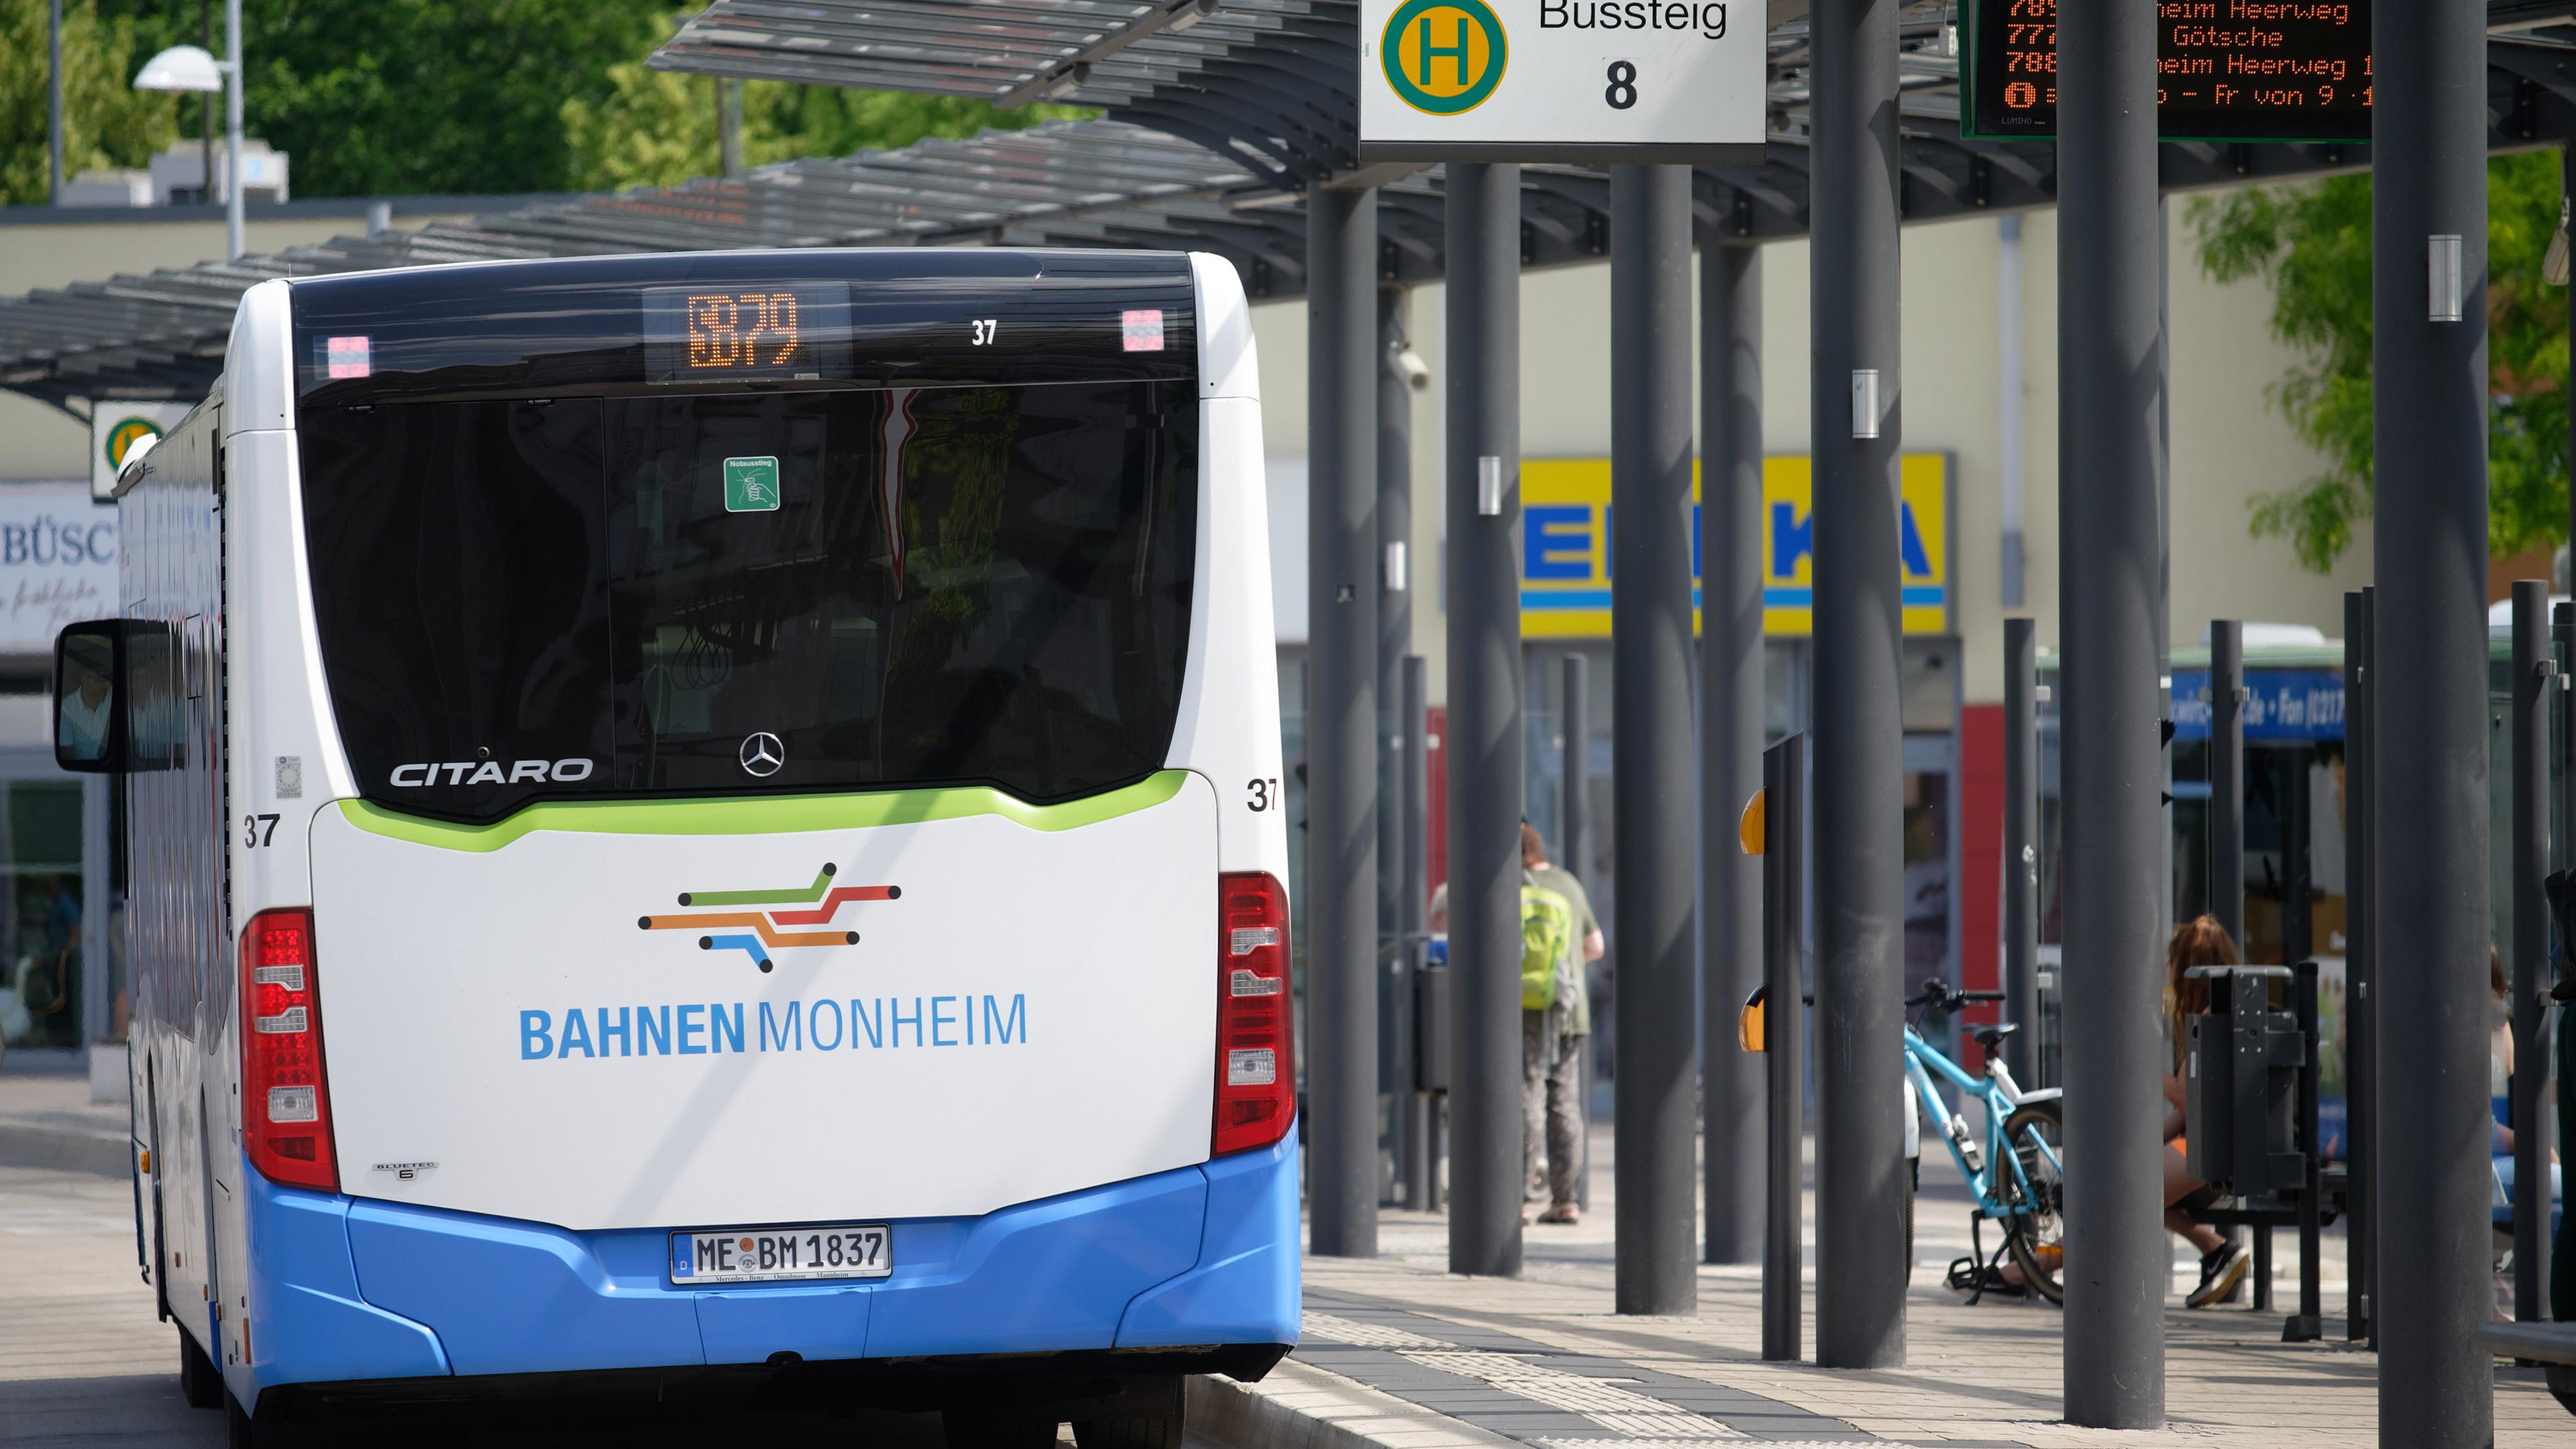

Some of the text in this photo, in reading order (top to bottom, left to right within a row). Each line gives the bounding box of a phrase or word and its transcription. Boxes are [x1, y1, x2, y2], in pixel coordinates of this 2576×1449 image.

[1540, 0, 1727, 40] Bussteig
[2231, 0, 2348, 25] Heerweg
[2174, 25, 2283, 47] Götsche
[2227, 54, 2346, 80] Heerweg
[1605, 60, 1638, 109] 8
[2215, 84, 2239, 105] Fr
[2255, 90, 2303, 106] von
[2318, 85, 2334, 106] 9
[2001, 117, 2032, 125] LUMINO
[971, 319, 998, 346] 37
[729, 459, 772, 468] Notausstieg
[3, 514, 118, 566] BÜSC
[390, 758, 594, 788] CITARO
[1247, 778, 1277, 812] 37
[244, 813, 280, 849] 37
[519, 993, 1027, 1061] BAHNEN MONHEIM
[399, 1169, 414, 1179] 6
[680, 1232, 883, 1271] D ME BM 1837
